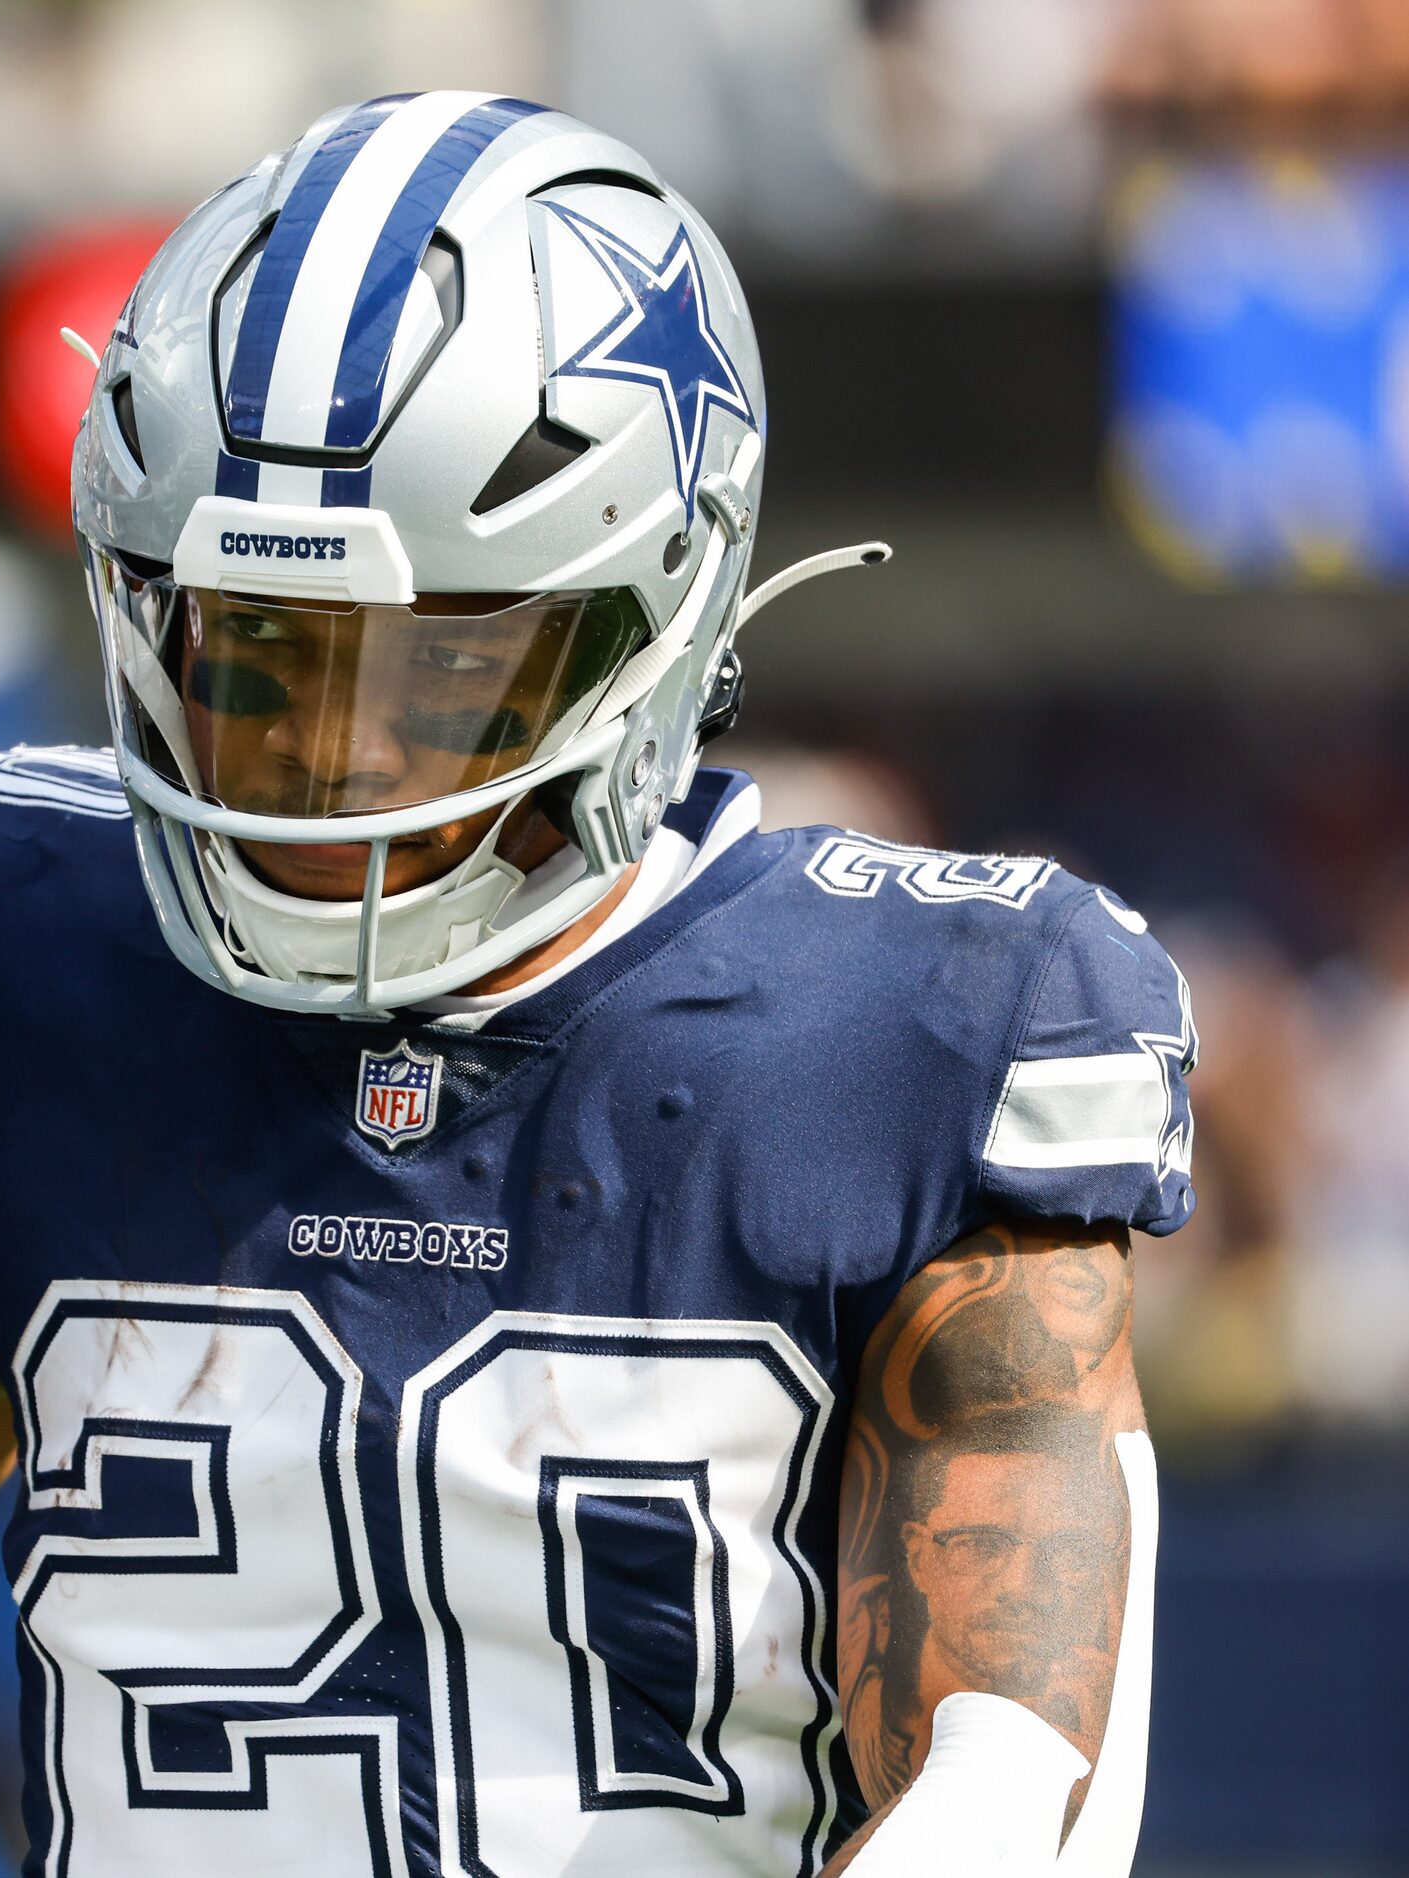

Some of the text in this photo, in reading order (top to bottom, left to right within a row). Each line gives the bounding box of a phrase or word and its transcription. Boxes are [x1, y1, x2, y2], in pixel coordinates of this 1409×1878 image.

[220, 532, 346, 560] COWBOYS
[367, 1087, 422, 1130] NFL
[288, 1215, 508, 1272] COWBOYS
[11, 1279, 837, 1878] 20
